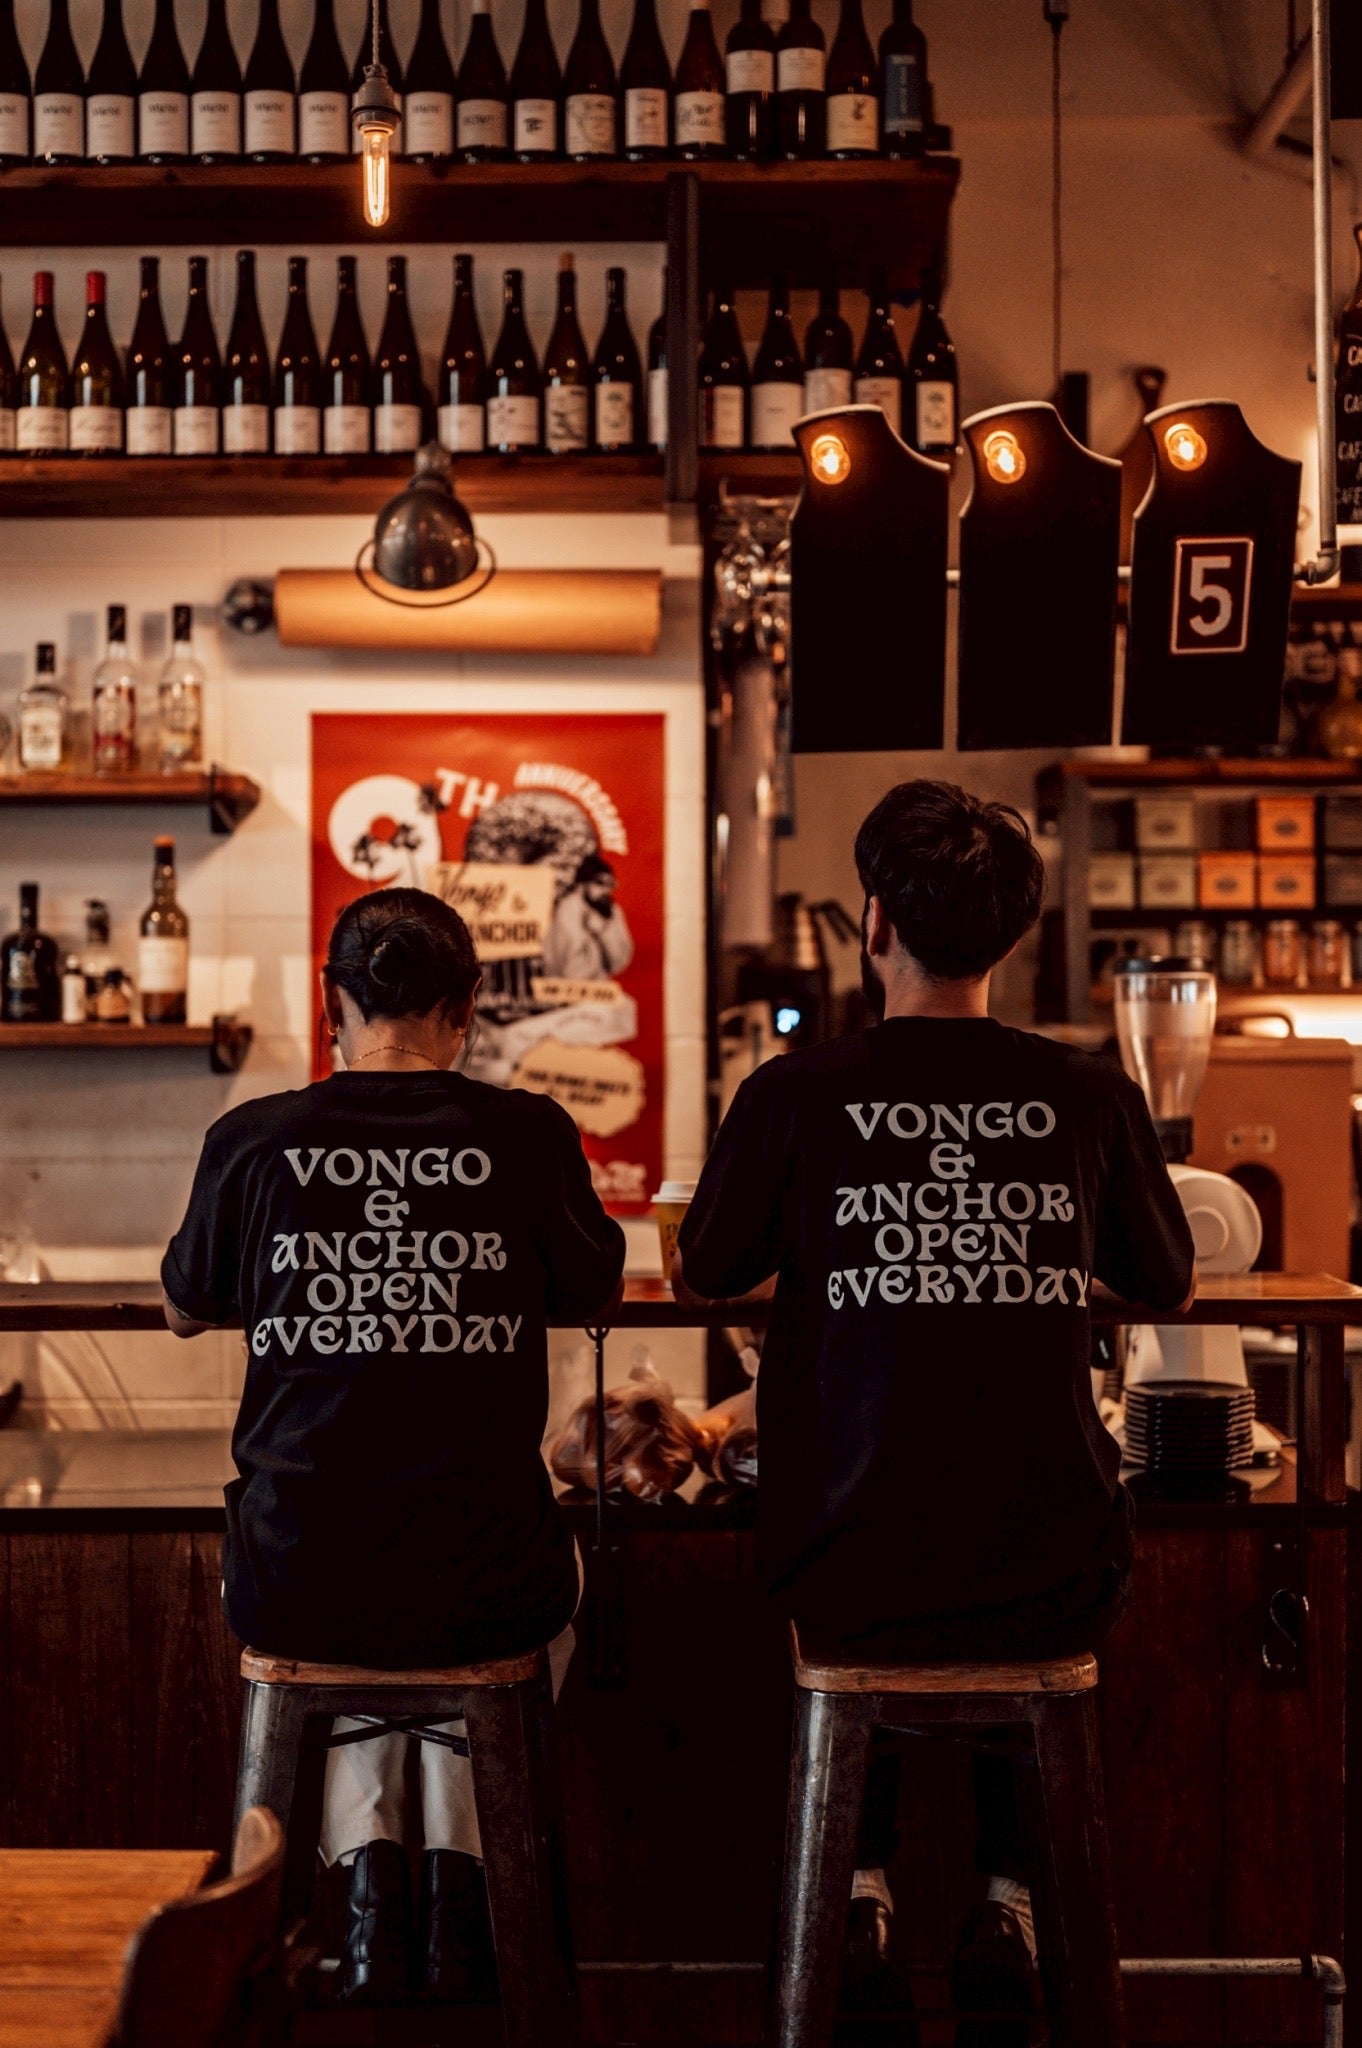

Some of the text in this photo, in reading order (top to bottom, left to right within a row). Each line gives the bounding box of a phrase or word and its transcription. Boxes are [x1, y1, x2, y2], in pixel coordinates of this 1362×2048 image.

[1190, 556, 1232, 636] 5
[845, 1102, 1056, 1141] VONGO
[284, 1147, 492, 1187] VONGO
[929, 1142, 976, 1180] &
[364, 1189, 410, 1228] &
[835, 1182, 1075, 1226] ANCHOR
[271, 1230, 507, 1274] ANCHOR
[874, 1223, 1031, 1264] OPEN
[306, 1272, 462, 1313] OPEN
[827, 1264, 1089, 1310] EVERYDAY
[252, 1313, 522, 1357] EVERYDAY
